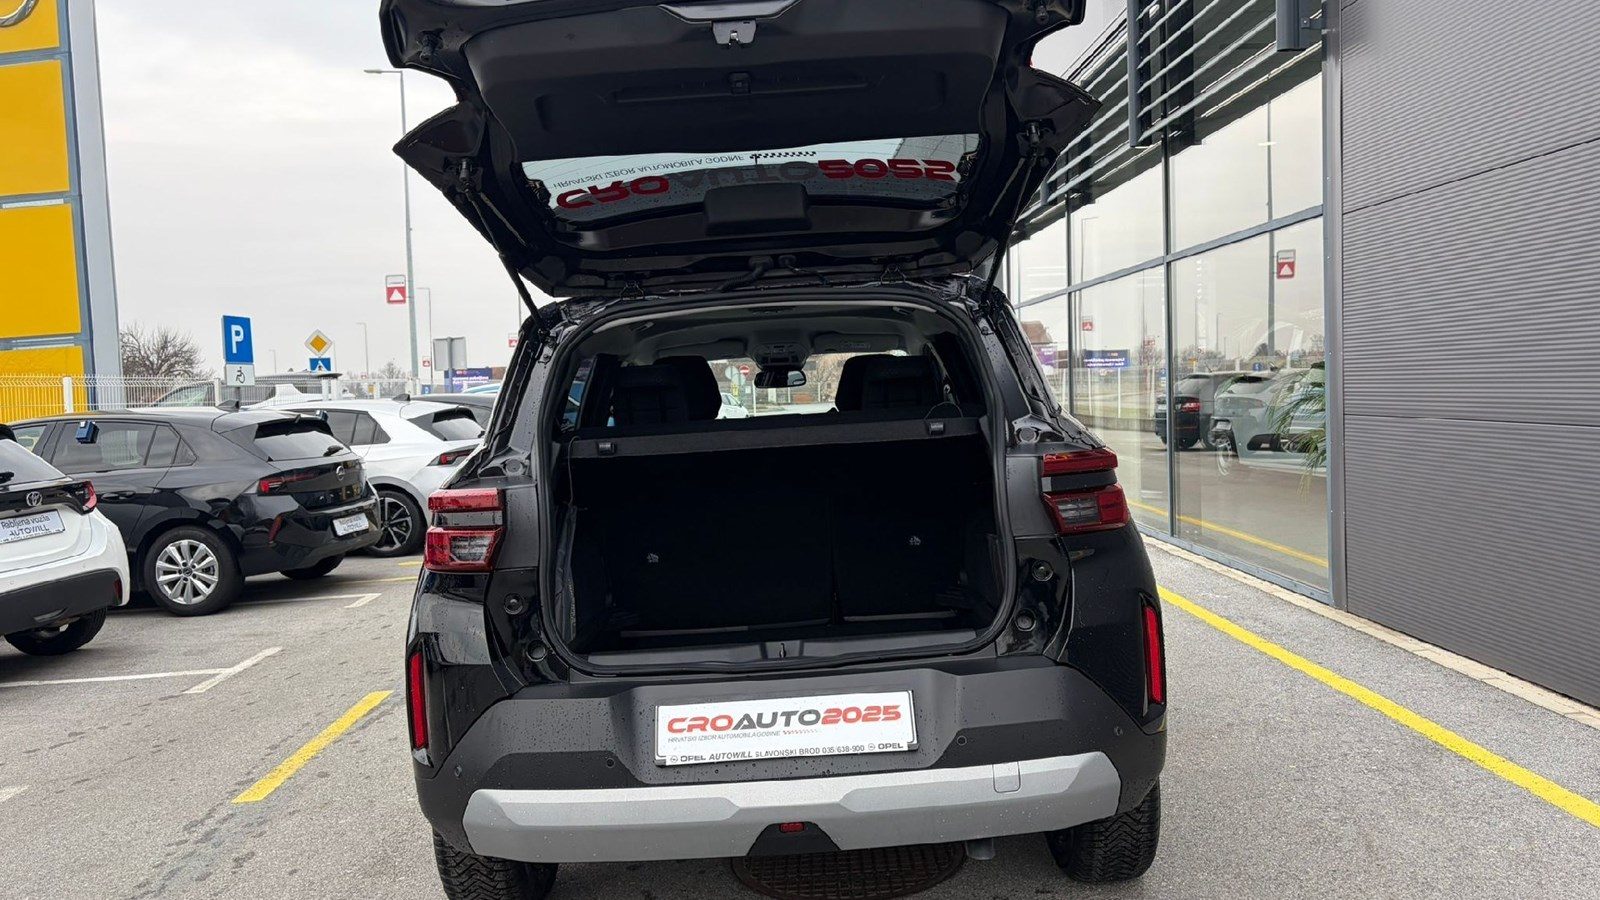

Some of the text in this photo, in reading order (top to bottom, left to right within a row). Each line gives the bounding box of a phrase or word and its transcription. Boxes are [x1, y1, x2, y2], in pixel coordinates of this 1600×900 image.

[231, 324, 244, 354] P
[668, 735, 697, 743] HRVATSKI
[717, 732, 756, 740] AUTOMOBILA
[756, 730, 781, 738] GODINE
[709, 750, 752, 760] AUTOWILL
[755, 748, 797, 758] SLAVONSKI
[799, 747, 820, 755] BROD
[877, 742, 903, 750] OPEL
